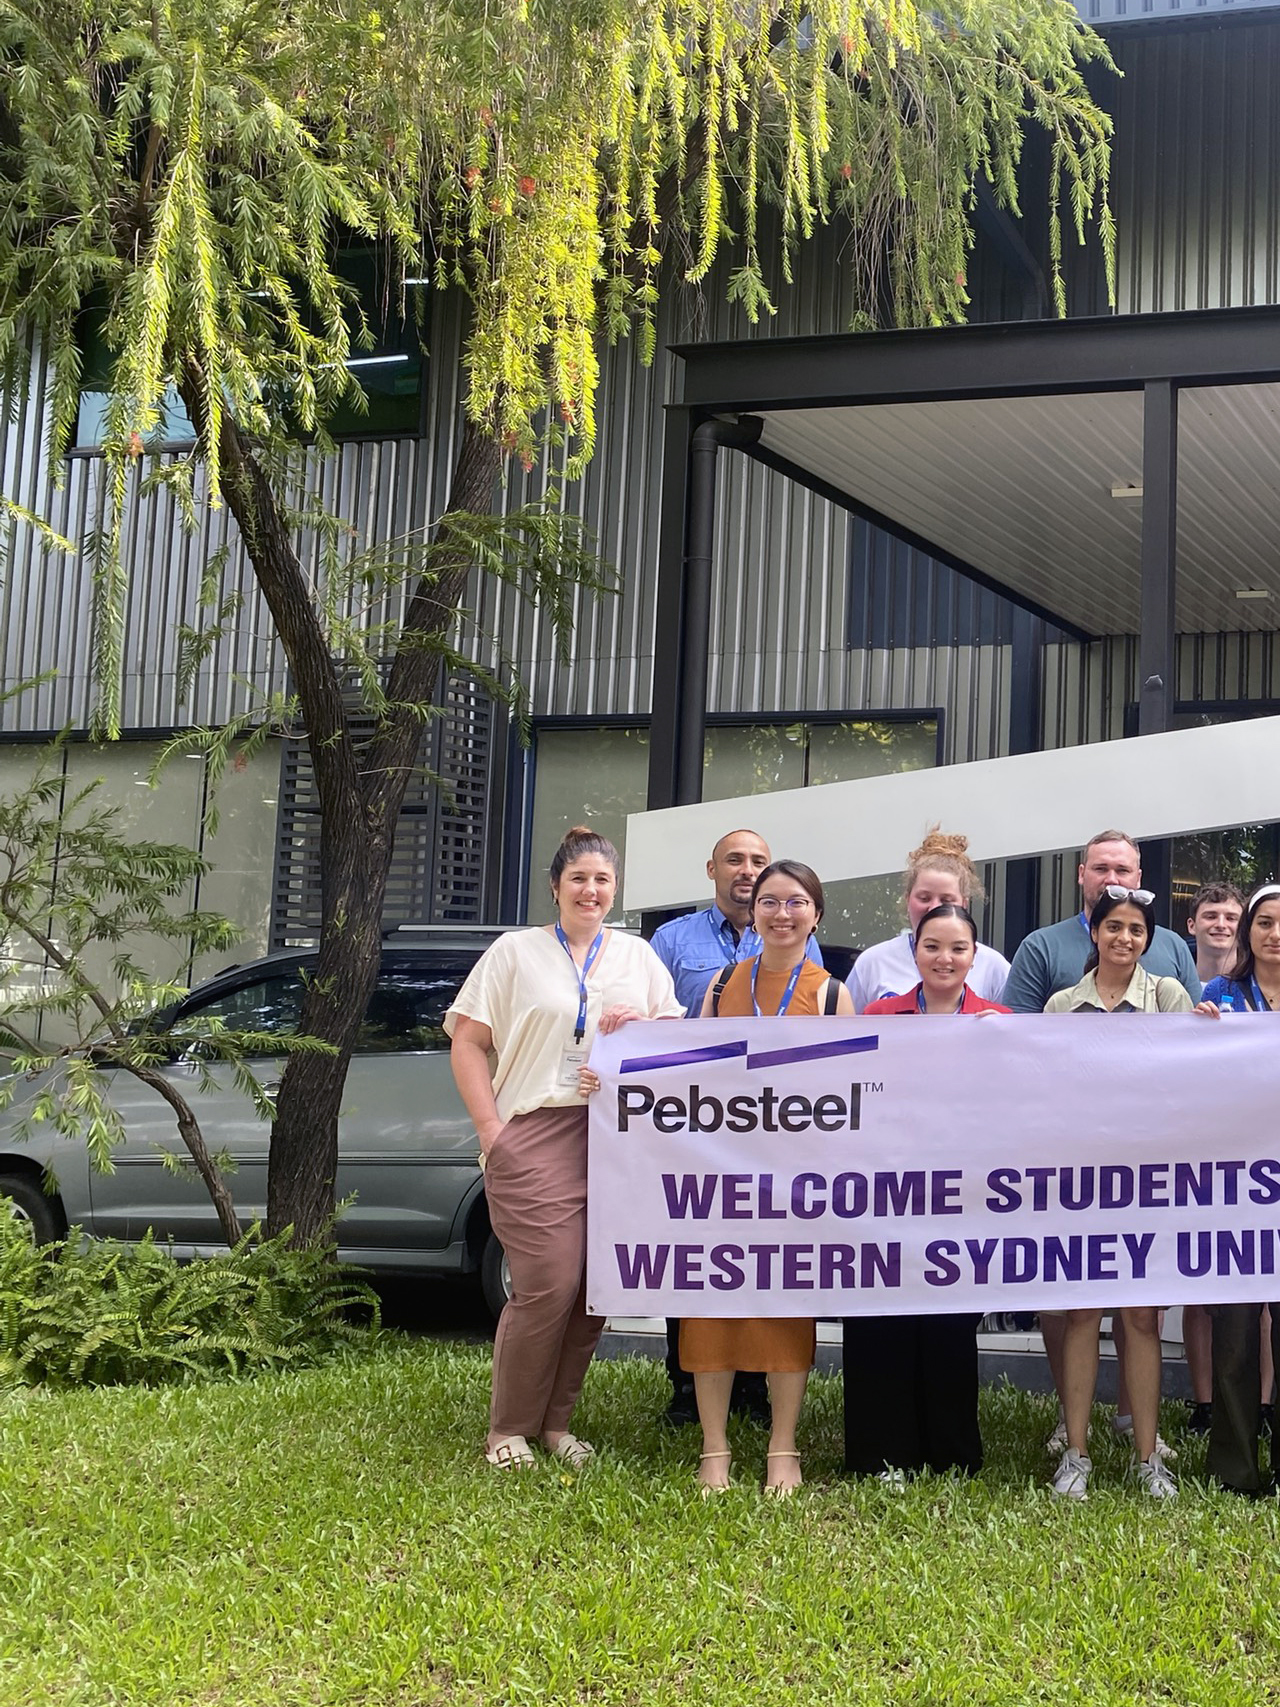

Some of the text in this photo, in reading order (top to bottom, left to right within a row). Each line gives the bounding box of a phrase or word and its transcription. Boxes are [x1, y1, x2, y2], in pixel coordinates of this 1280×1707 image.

[617, 1082, 862, 1134] Pebsteel
[661, 1169, 964, 1220] WELCOME
[614, 1241, 902, 1291] WESTERN
[923, 1232, 1157, 1287] SYDNEY
